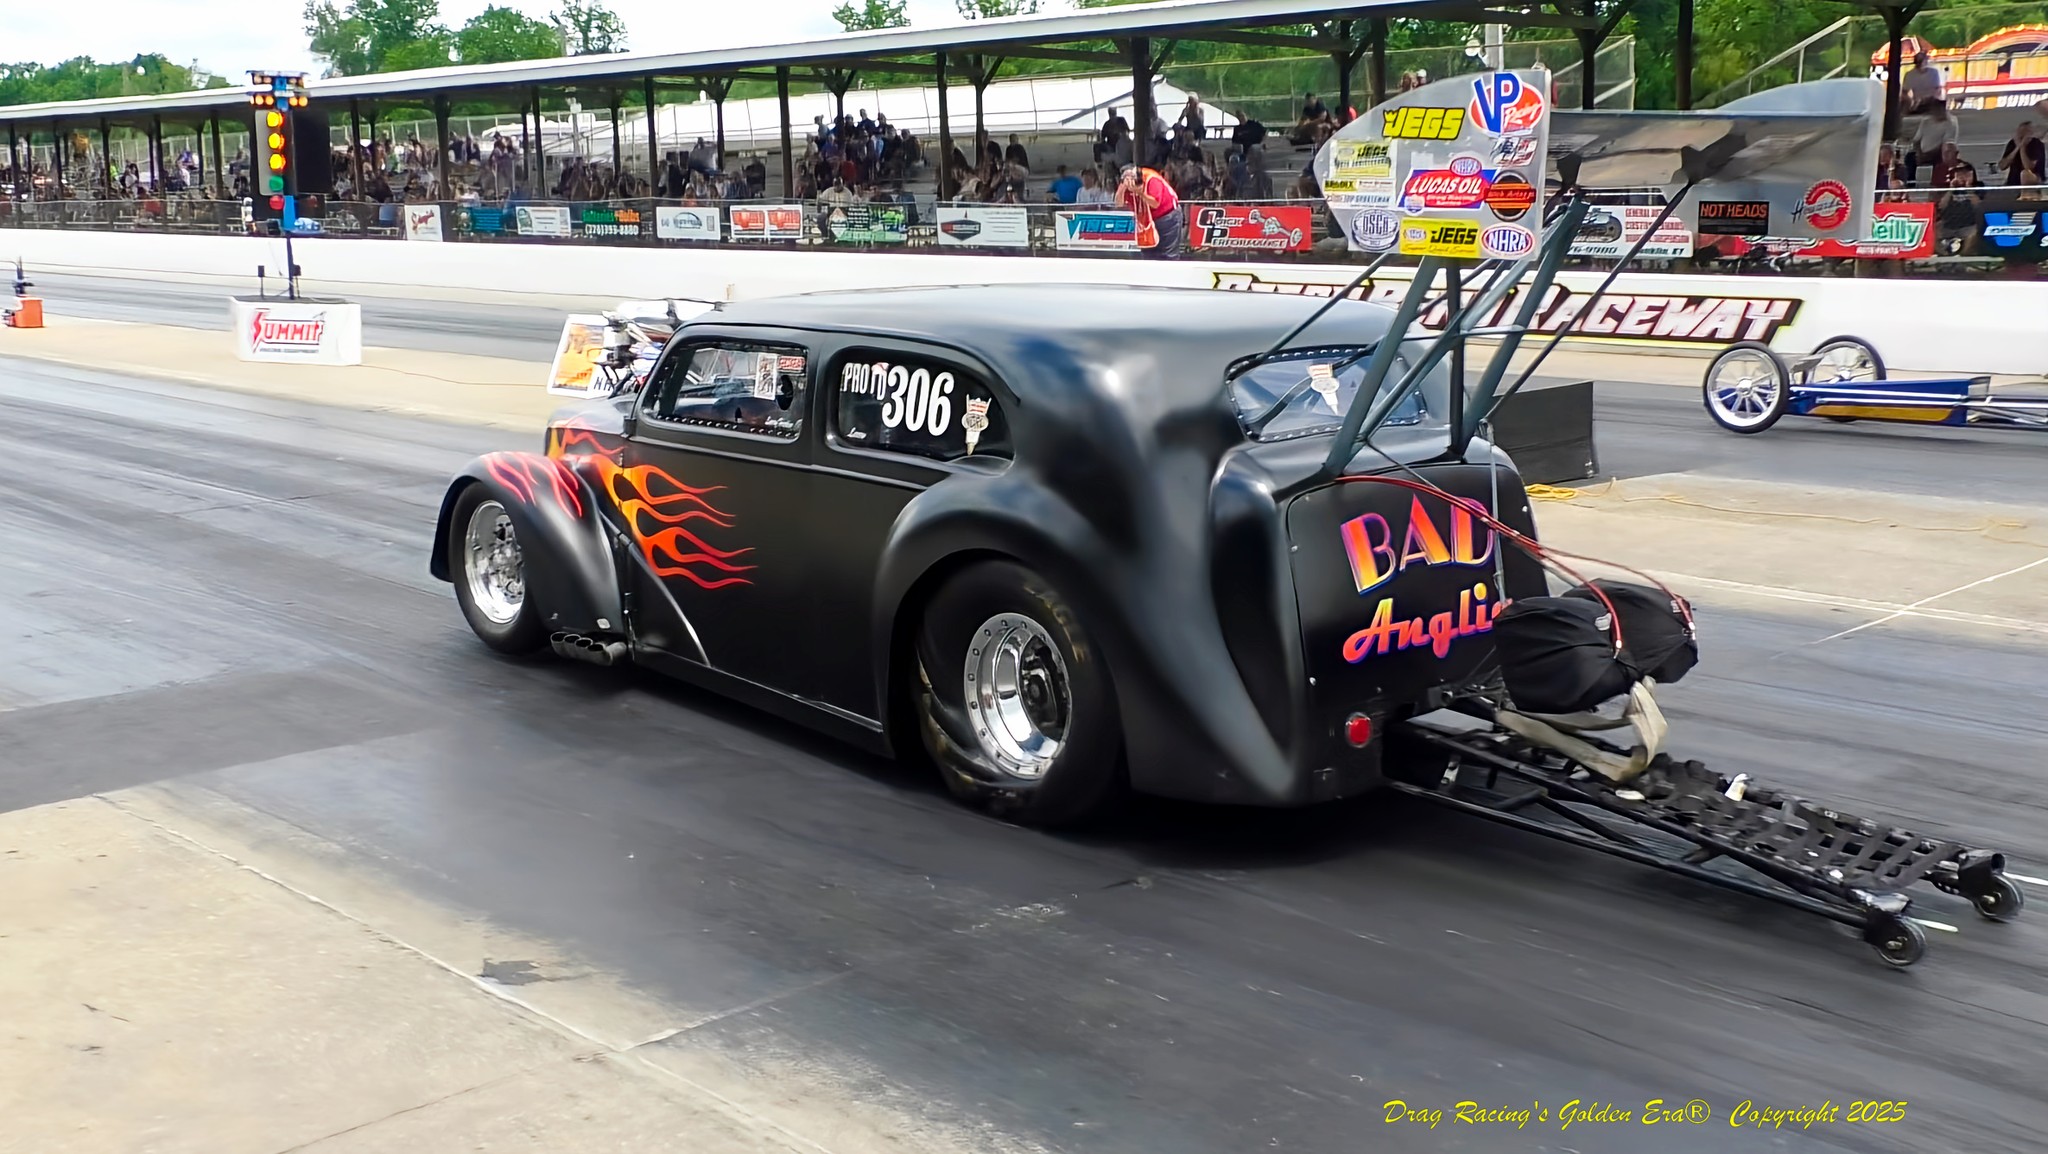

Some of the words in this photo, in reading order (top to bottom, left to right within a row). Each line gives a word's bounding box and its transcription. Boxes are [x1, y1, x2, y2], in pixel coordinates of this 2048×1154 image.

[1474, 72, 1520, 133] VP
[1382, 106, 1465, 140] JEGS
[1410, 177, 1457, 194] LUCAS
[1458, 178, 1482, 194] OIL
[1701, 204, 1724, 217] HOT
[1725, 204, 1768, 218] HEADS
[1430, 227, 1478, 245] JEGS
[1488, 229, 1527, 252] NHRA
[1493, 283, 1798, 342] RACEWAY
[252, 308, 322, 353] SUMMIT
[843, 362, 870, 394] PRO
[882, 365, 955, 436] 306
[1340, 494, 1496, 594] BAD
